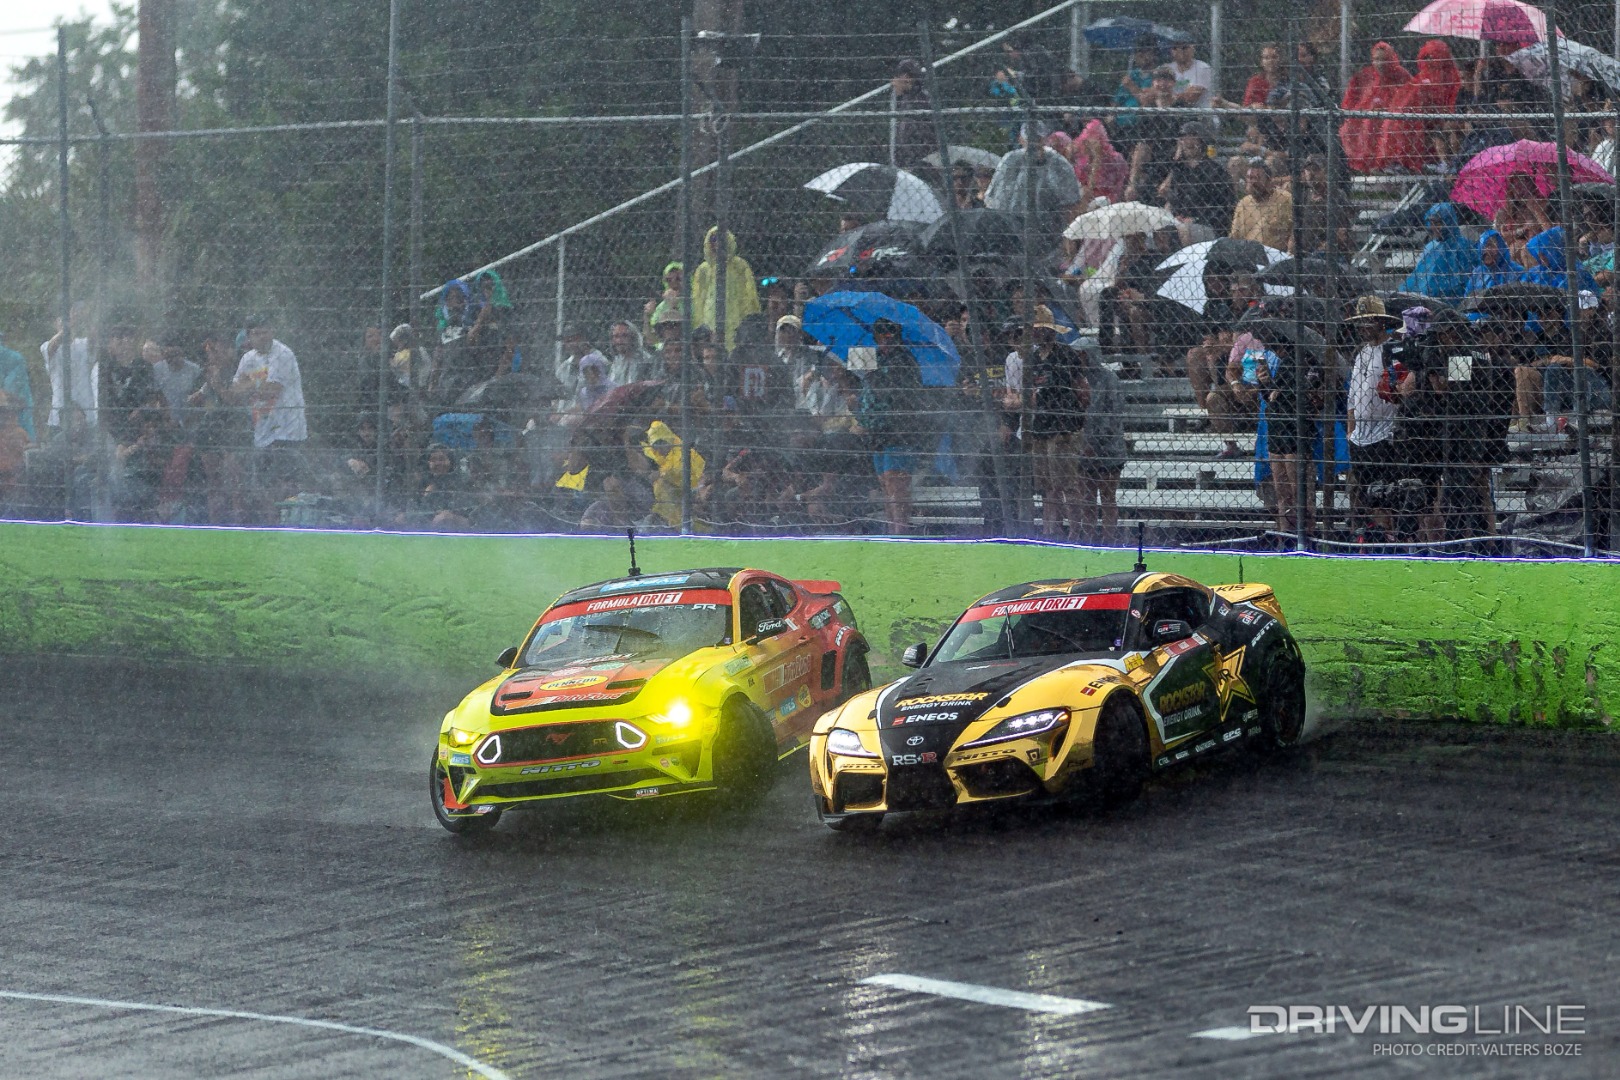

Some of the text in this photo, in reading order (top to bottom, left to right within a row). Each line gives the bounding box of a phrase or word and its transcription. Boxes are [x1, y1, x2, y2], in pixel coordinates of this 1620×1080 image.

[758, 621, 782, 632] Ford
[547, 677, 598, 689] PENNZOIL
[895, 692, 990, 708] ROCKSTAR
[900, 700, 972, 712] ENERGY DRINK
[906, 712, 958, 723] ENEOS
[1163, 705, 1203, 727] ENERGY DRINK
[957, 749, 1016, 761] NITTO
[520, 760, 601, 775] NITTO
